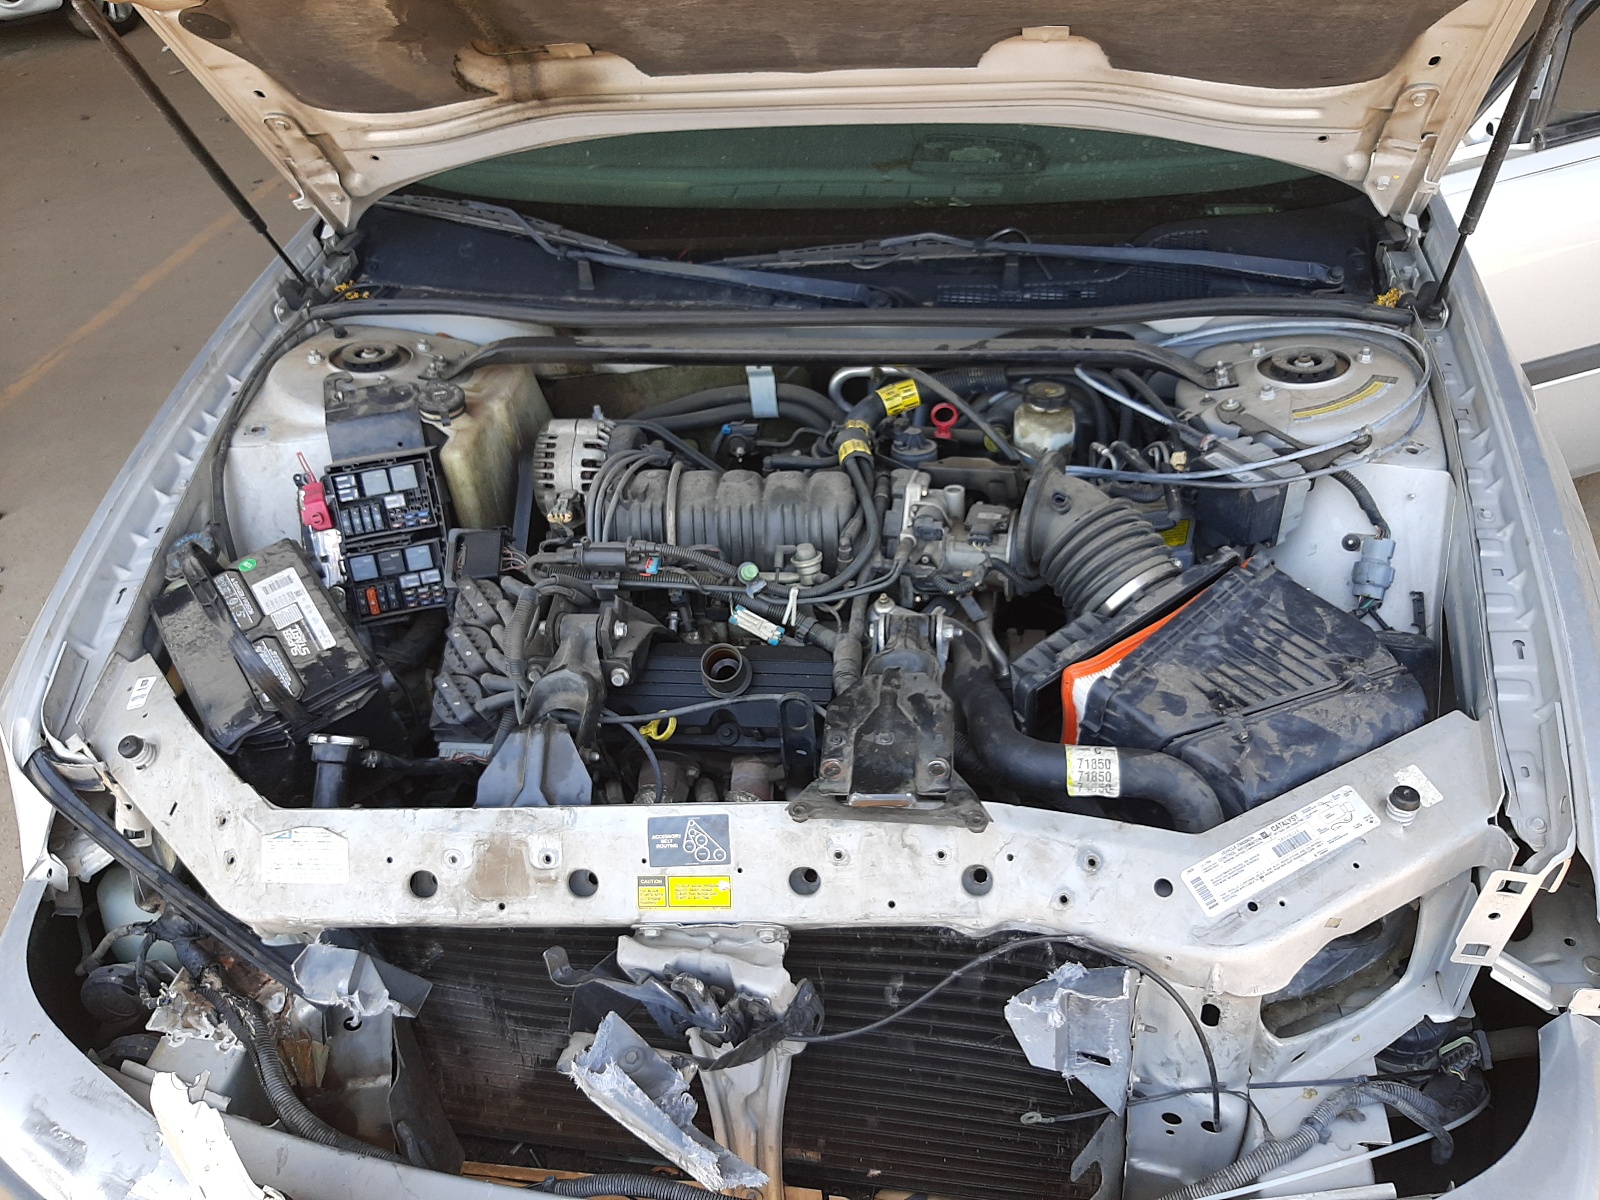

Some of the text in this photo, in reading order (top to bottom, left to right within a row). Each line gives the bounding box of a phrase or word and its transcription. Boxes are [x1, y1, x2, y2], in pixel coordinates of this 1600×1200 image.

[282, 628, 300, 656] SUPER
[288, 625, 311, 656] START
[1077, 758, 1111, 770] 71850
[1078, 771, 1112, 783] 71850
[1077, 783, 1112, 794] 7850
[1270, 814, 1299, 832] CATALYST
